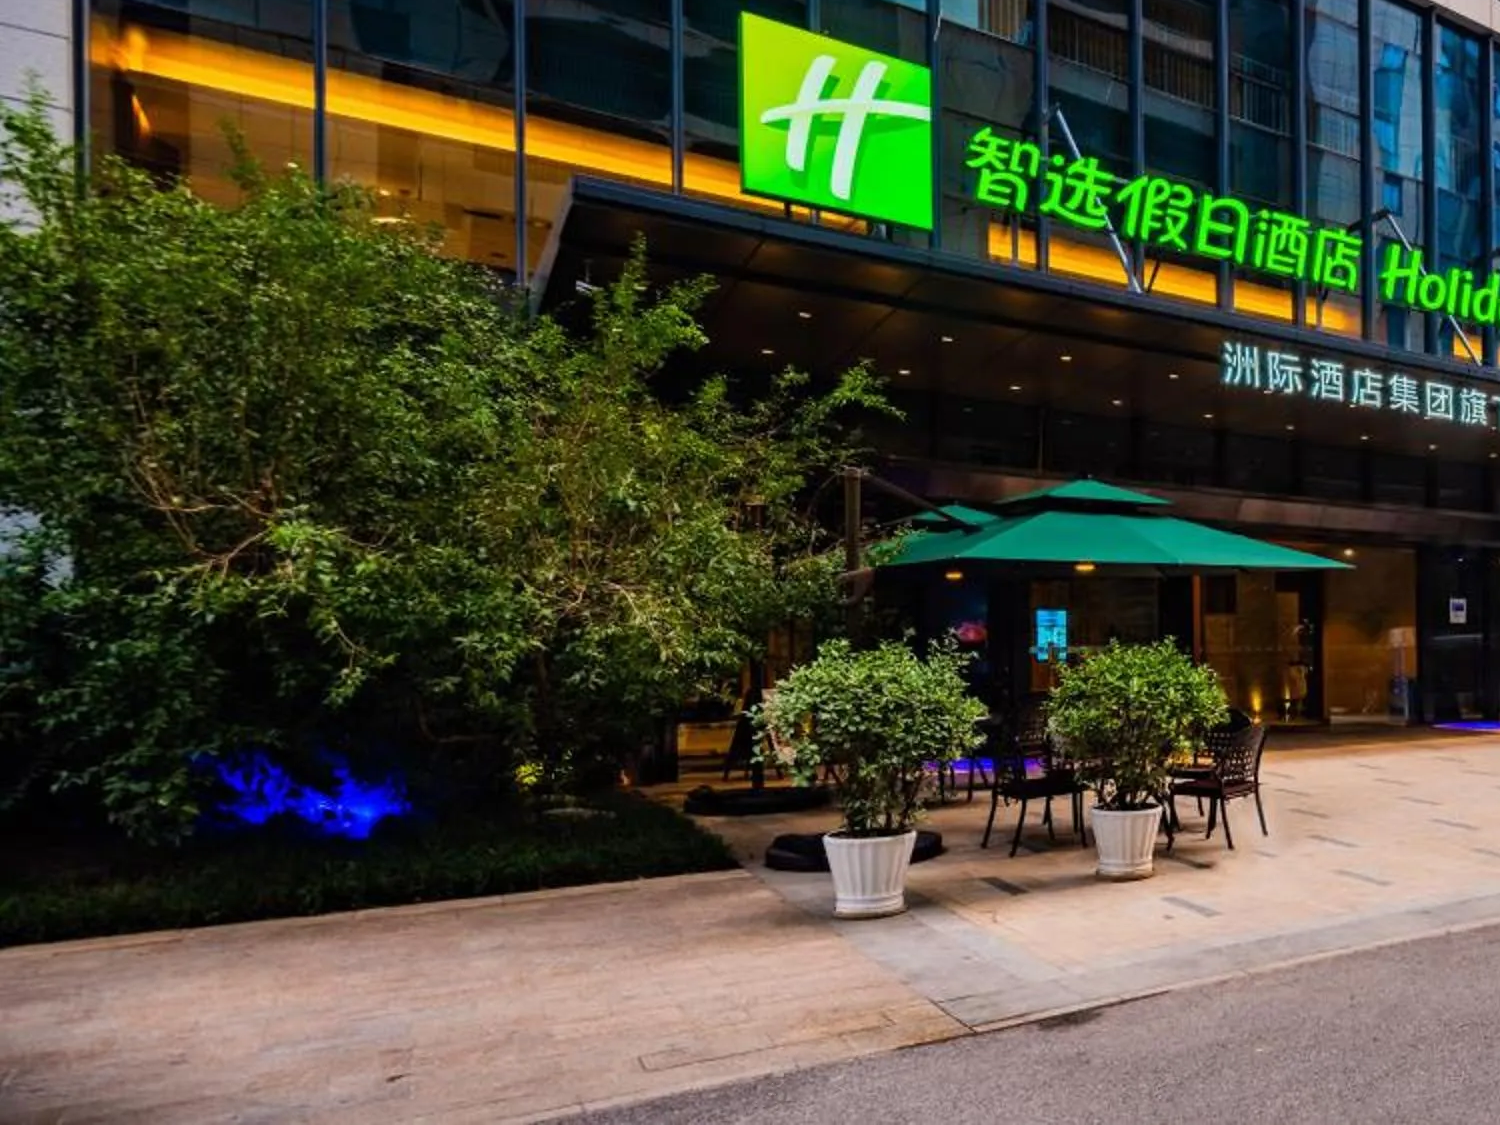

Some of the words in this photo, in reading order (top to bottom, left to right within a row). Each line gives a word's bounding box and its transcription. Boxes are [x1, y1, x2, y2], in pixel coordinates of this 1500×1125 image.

[965, 127, 1363, 293] 智选假日酒店
